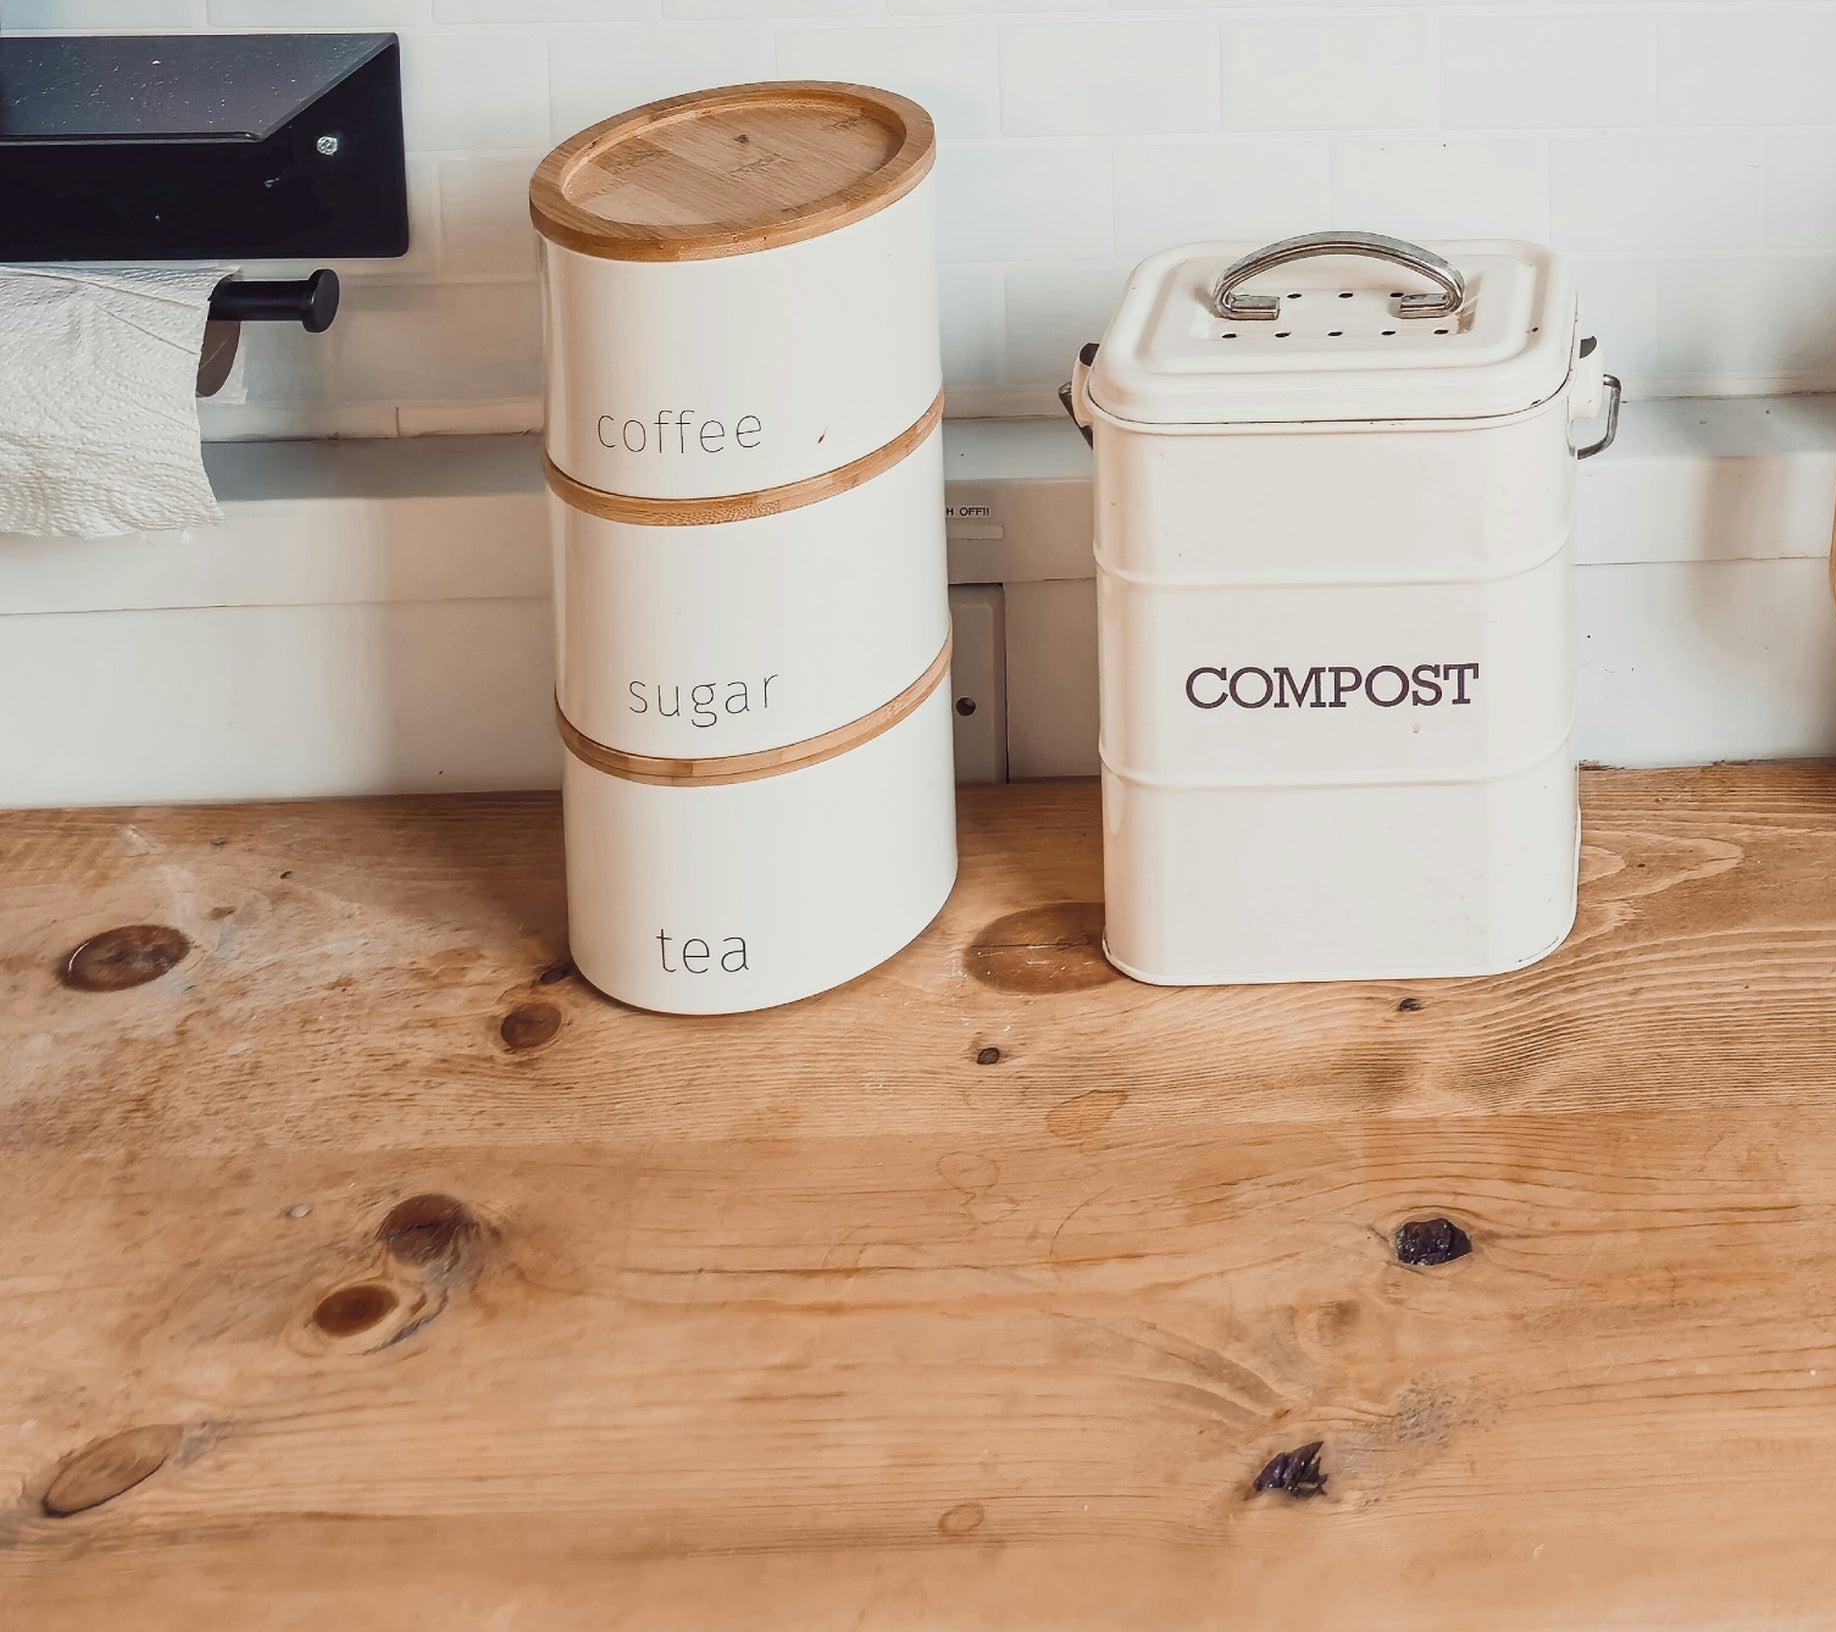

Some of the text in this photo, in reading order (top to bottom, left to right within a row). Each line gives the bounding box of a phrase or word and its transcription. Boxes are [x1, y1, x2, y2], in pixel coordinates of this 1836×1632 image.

[597, 409, 762, 454] coffee
[628, 673, 779, 729] sugar
[1185, 662, 1480, 709] COMPOST
[656, 928, 750, 974] tea
